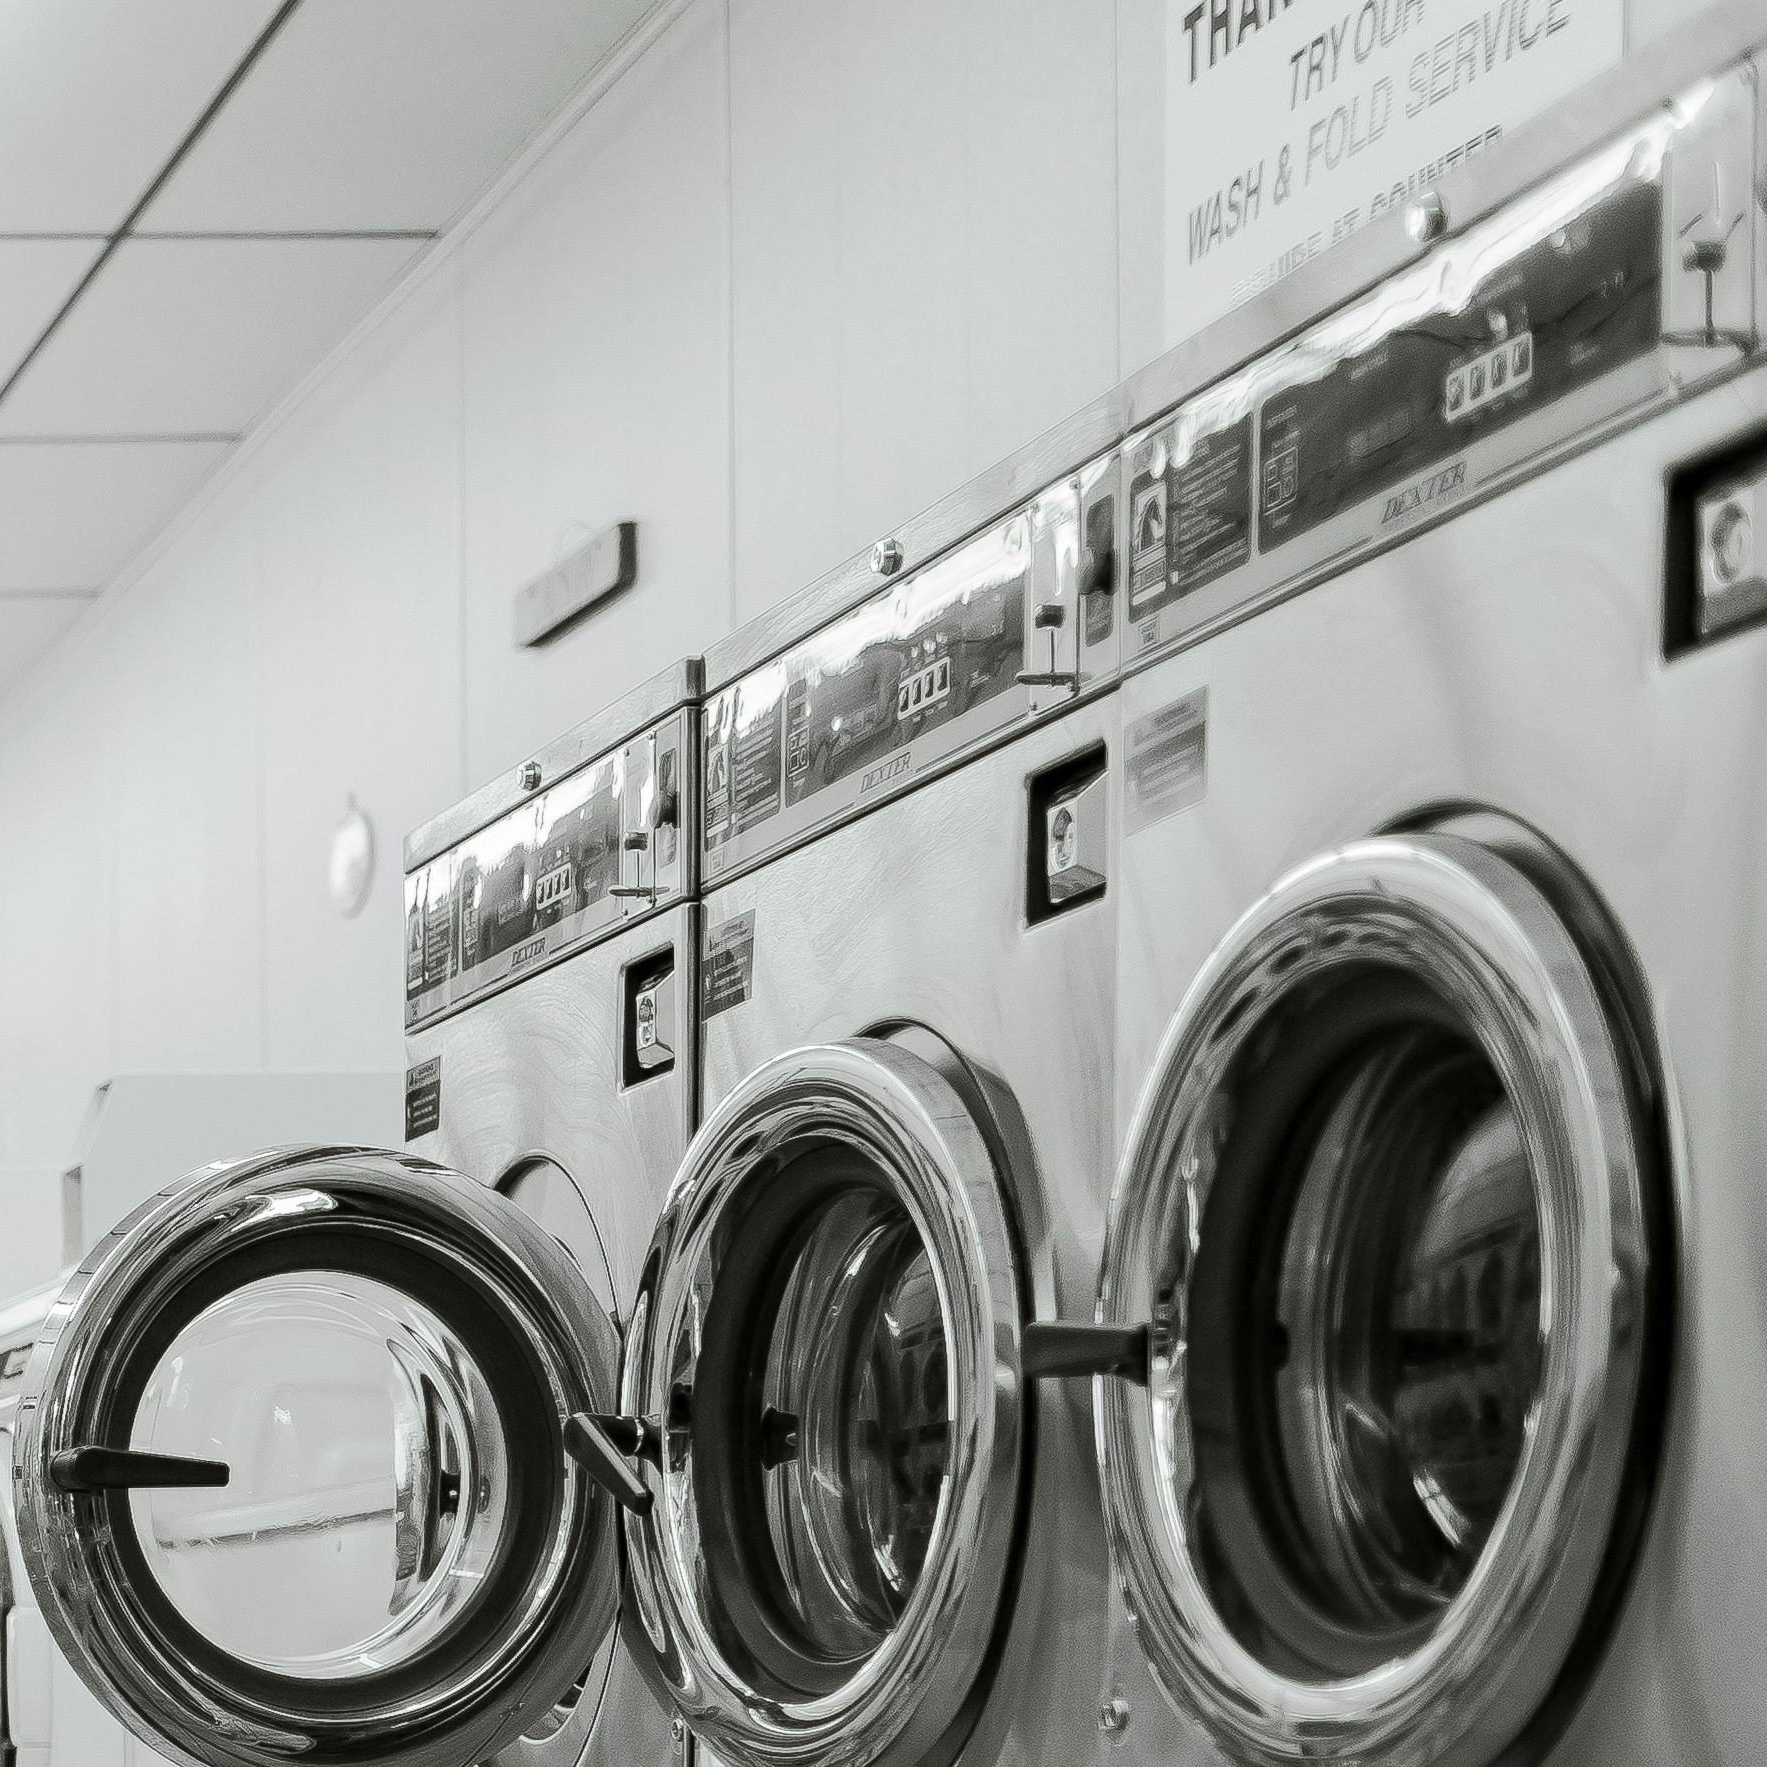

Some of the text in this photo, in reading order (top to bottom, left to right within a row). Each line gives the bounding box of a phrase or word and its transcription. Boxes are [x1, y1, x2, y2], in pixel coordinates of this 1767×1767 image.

[1183, 0, 1294, 84] THA
[1289, 0, 1426, 111] TRY OUR
[1187, 0, 1572, 267] WASH & FOLD SERVICE
[1380, 461, 1468, 525] DEXTER
